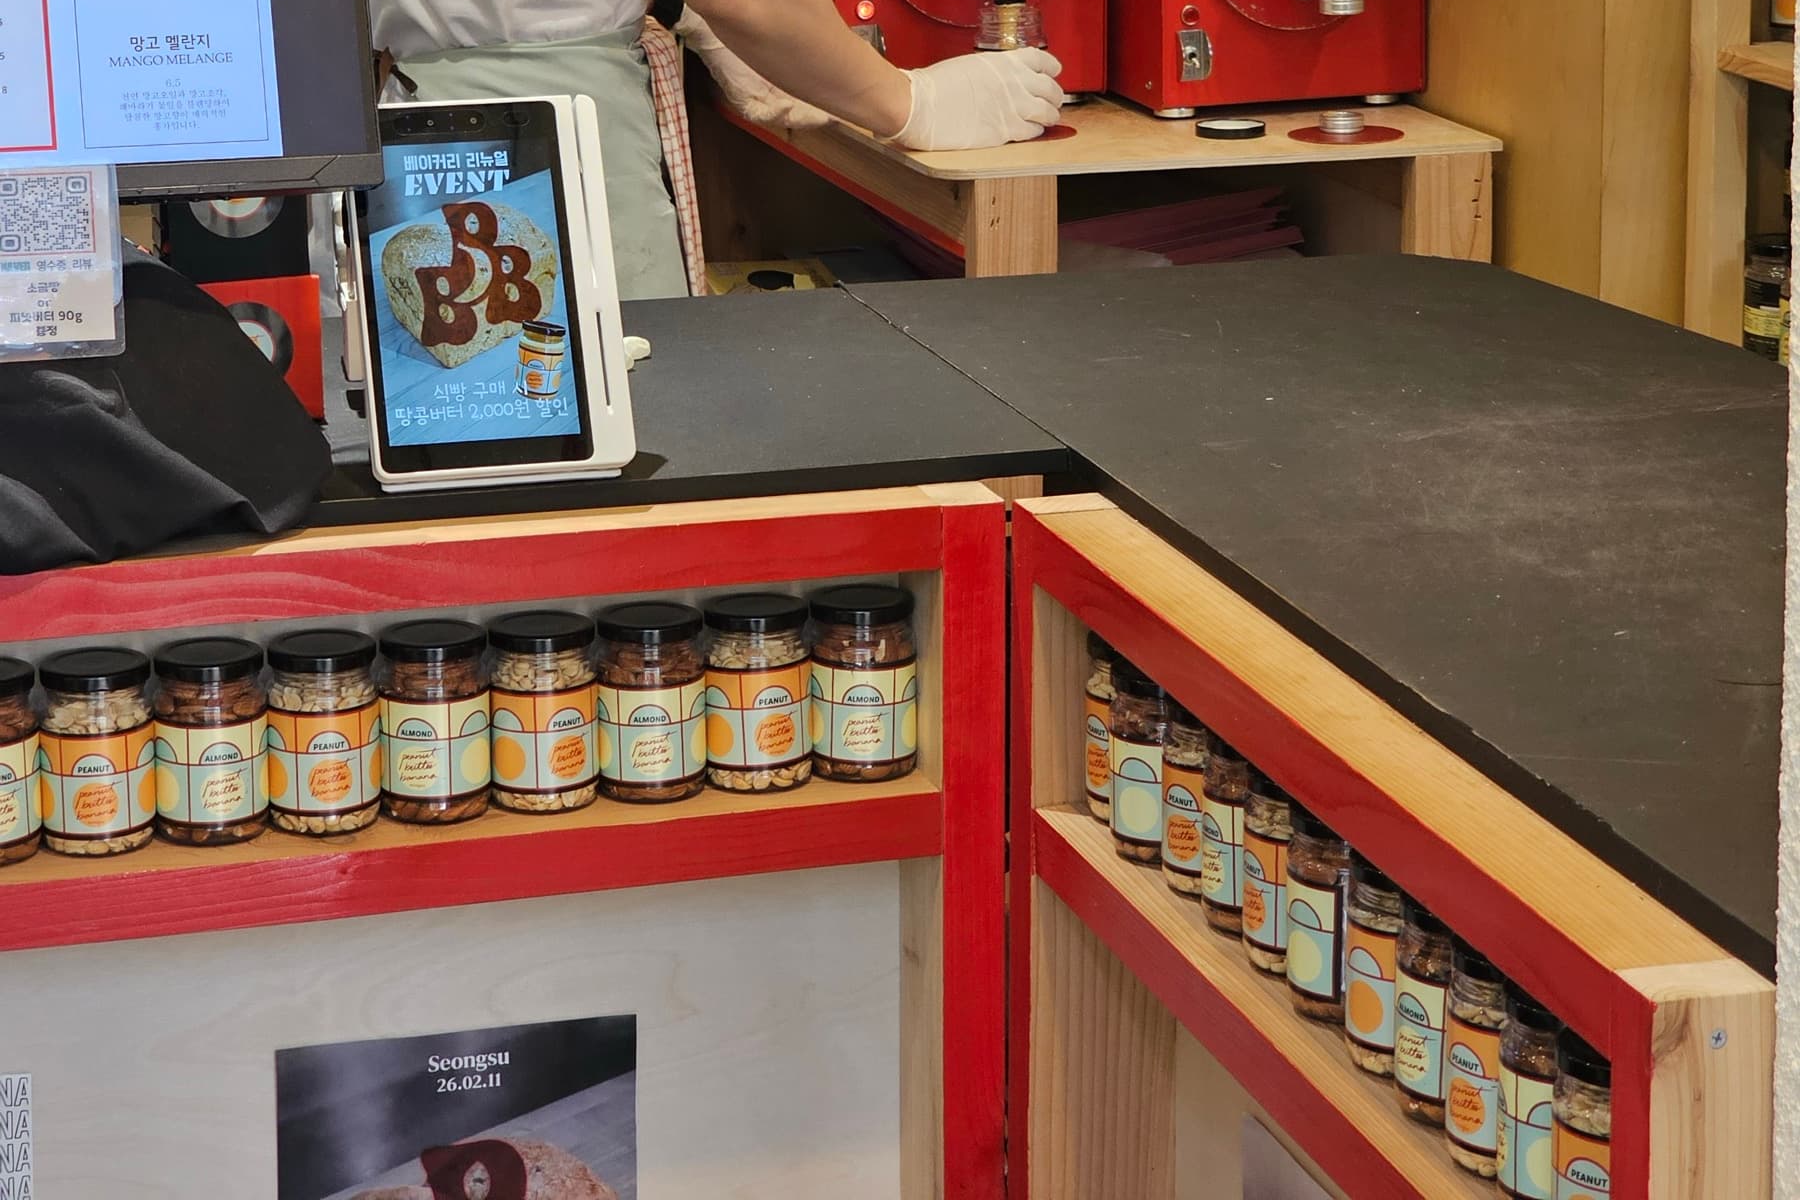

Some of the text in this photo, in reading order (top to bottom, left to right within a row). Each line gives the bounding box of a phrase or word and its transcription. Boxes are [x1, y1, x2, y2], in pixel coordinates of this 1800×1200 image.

[130, 34, 210, 52] 망고 멜란지
[109, 52, 233, 67] MANGO MELANGE
[166, 79, 181, 88] 6.5
[404, 151, 508, 171] 베이커리 리뉴얼
[404, 169, 510, 196] EVENT
[36, 259, 66, 271] 영수증
[73, 258, 92, 270] 리뷰
[27, 281, 60, 293] 소금빵
[9, 310, 83, 323] 피넛버터 90g
[433, 382, 467, 403] 식빵
[472, 380, 506, 399] 구매
[512, 380, 528, 396] 시
[395, 397, 569, 427] 땅콩버터 2,000원 할인
[758, 695, 789, 706] PEANUT
[847, 695, 880, 704] ALMOND
[553, 717, 582, 729] PEANUT
[633, 714, 667, 723] ALMOND
[401, 729, 433, 738] ALMOND
[313, 741, 345, 751] PEANUT
[205, 752, 239, 762] ALMOND
[77, 765, 110, 774] PEANUT
[1168, 794, 1193, 808] PEANUT
[427, 1051, 510, 1072] Seongsu
[1452, 1052, 1480, 1072] PEANUT
[437, 1073, 501, 1093] 26.02.11
[1571, 1168, 1609, 1188] PEANUT
